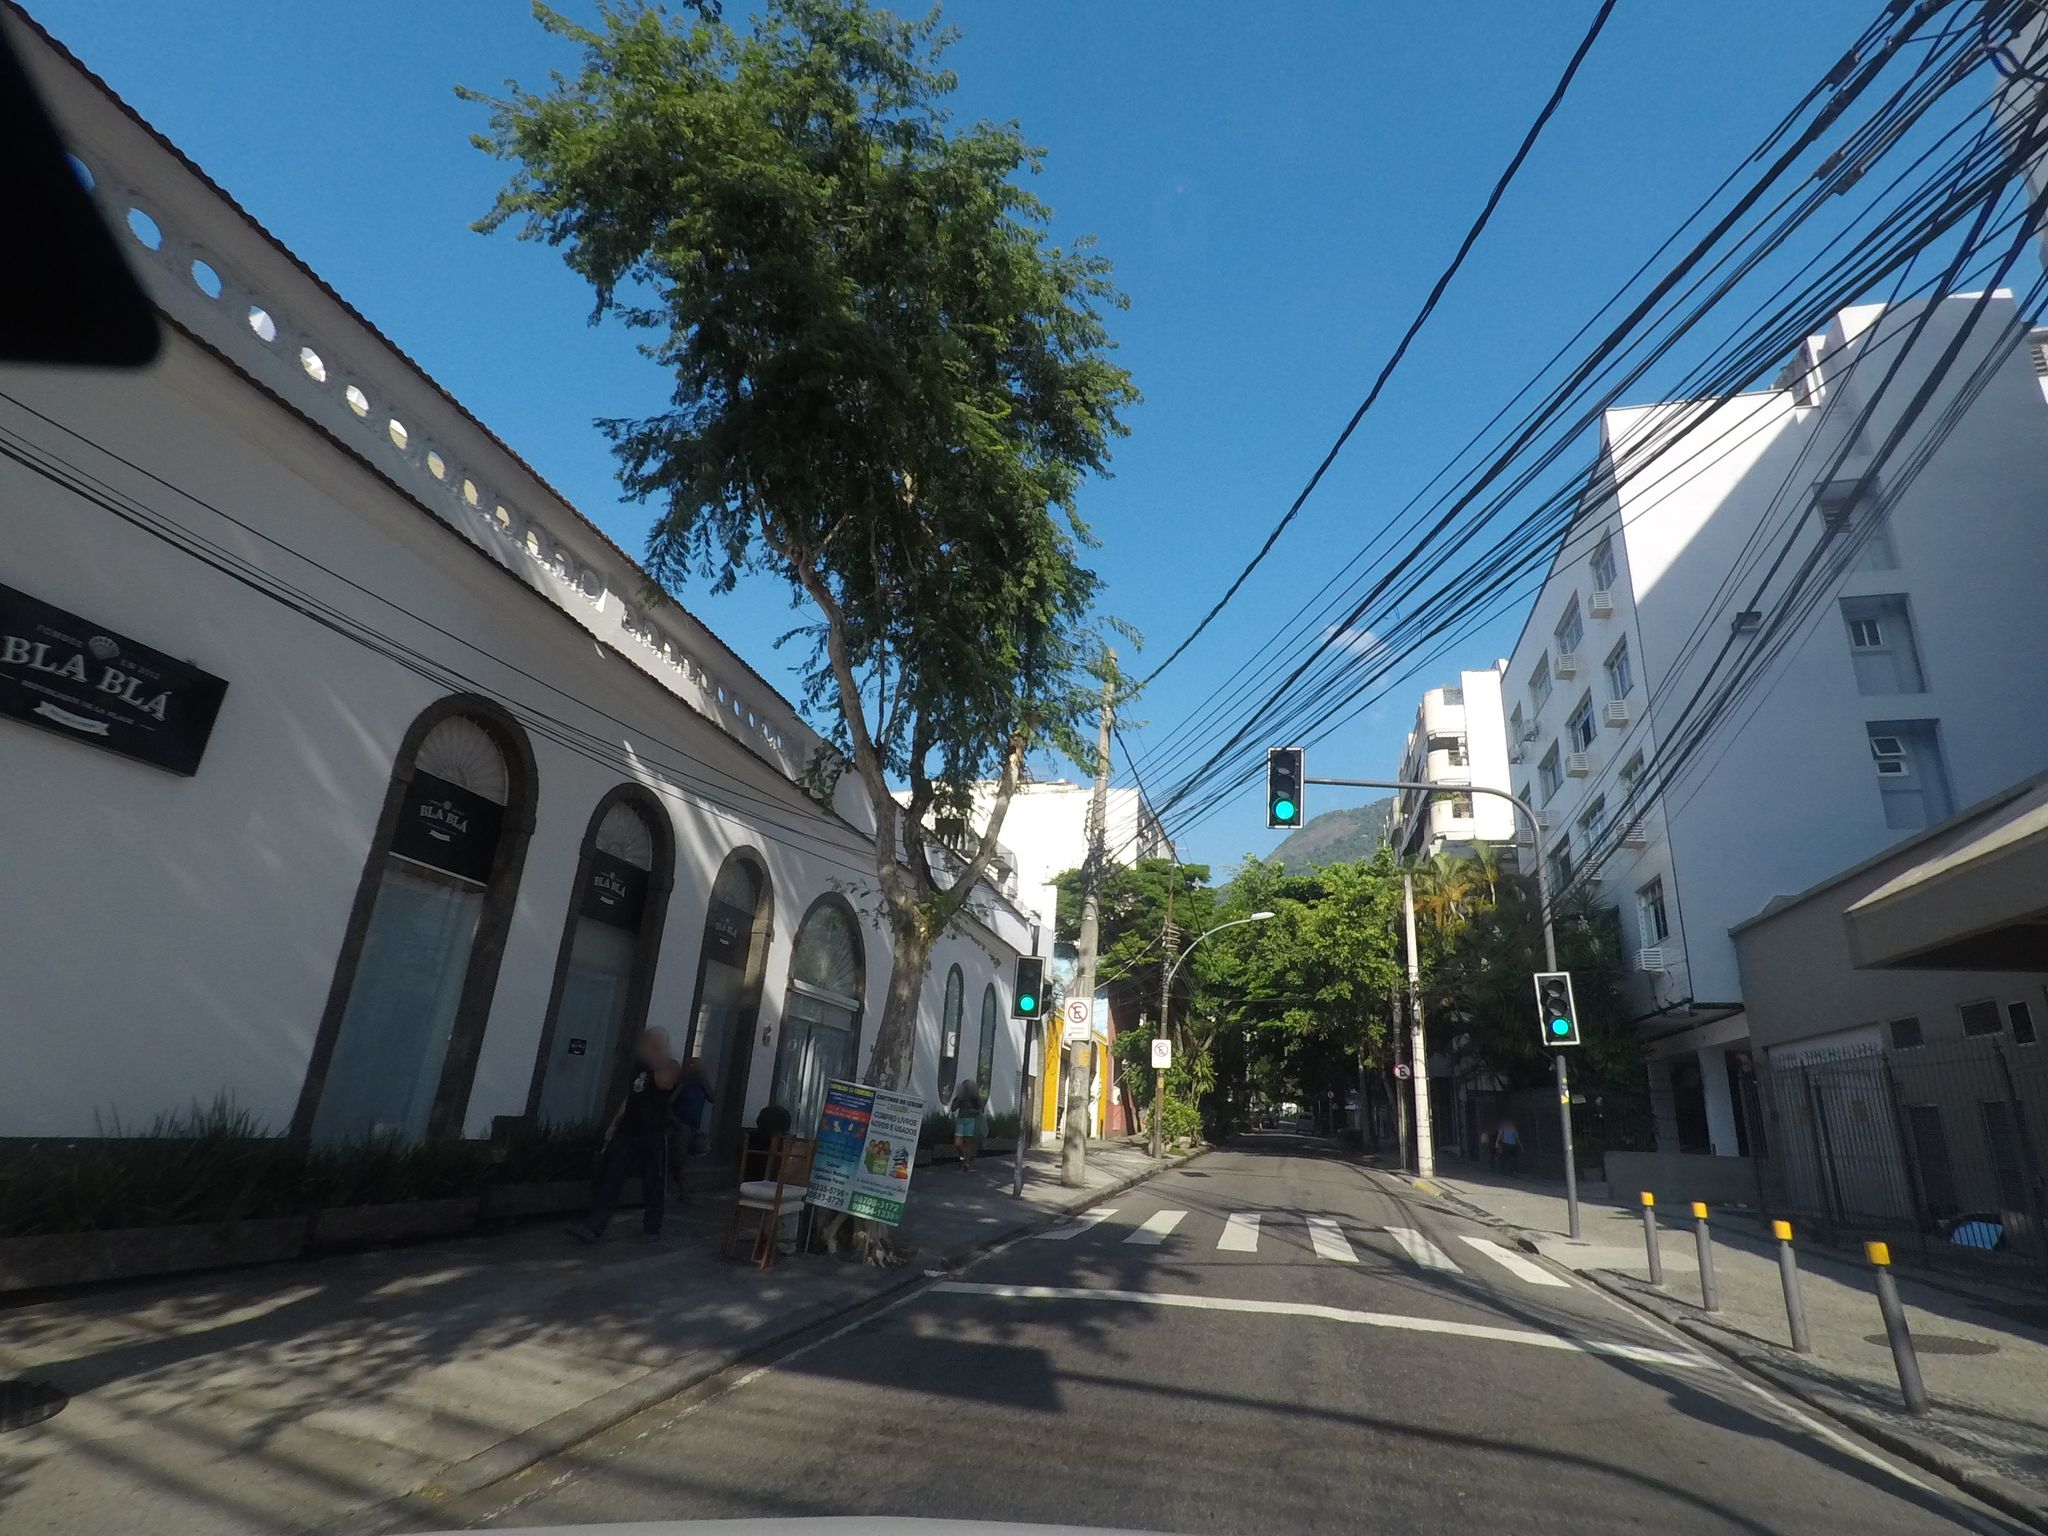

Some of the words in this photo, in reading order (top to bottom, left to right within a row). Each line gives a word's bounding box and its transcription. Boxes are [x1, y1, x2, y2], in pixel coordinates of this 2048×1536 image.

[0, 635, 88, 683] BLA
[96, 665, 173, 721] BLÁ
[419, 805, 443, 820] BLA
[897, 1116, 917, 1127] LIVROS
[894, 1124, 917, 1136] USADOS
